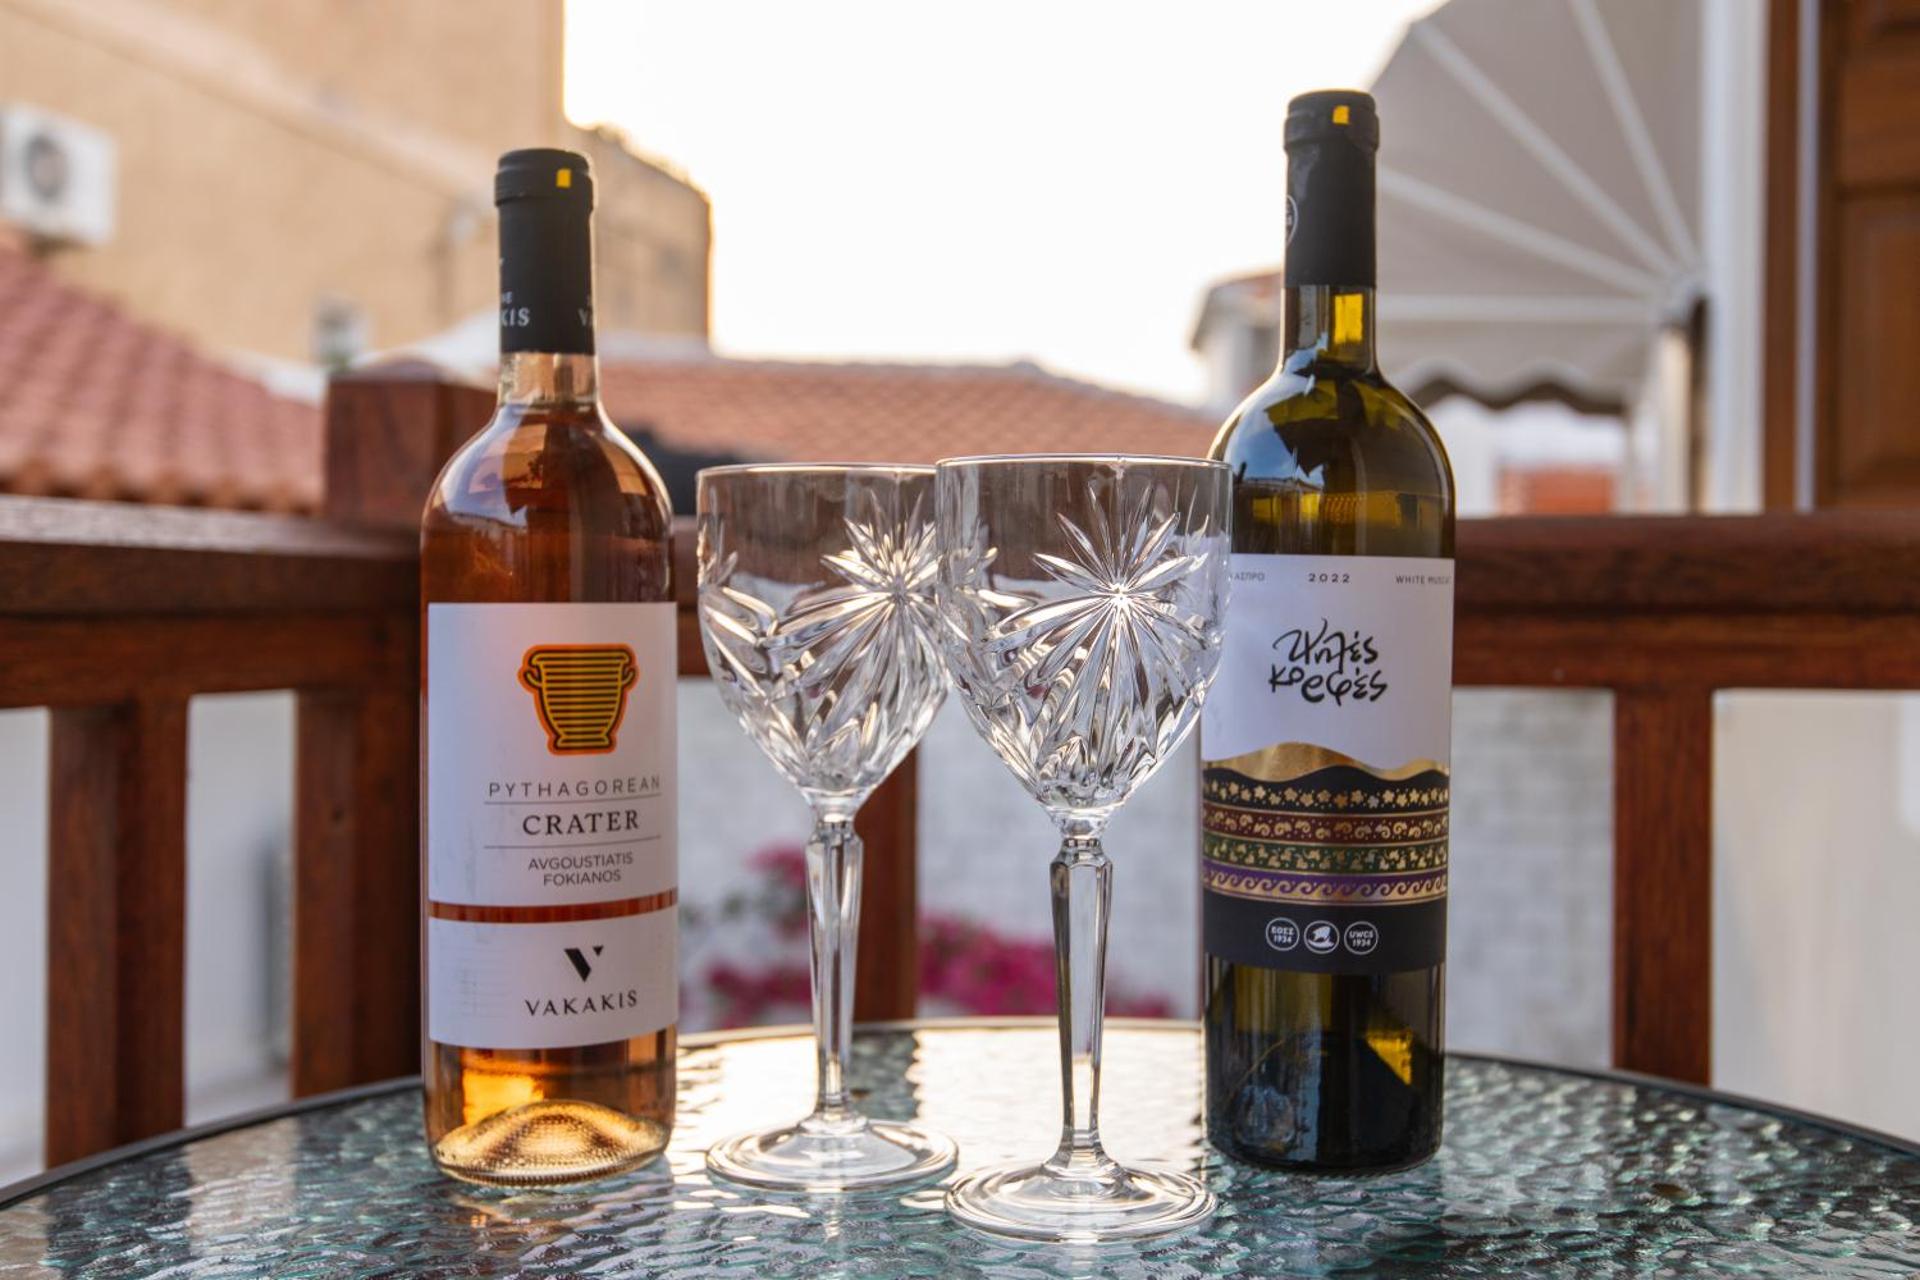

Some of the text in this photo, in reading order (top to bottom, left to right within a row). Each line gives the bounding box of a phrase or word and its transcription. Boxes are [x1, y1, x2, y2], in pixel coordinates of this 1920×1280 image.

[1308, 572, 1350, 583] 2022
[1395, 575, 1425, 585] WHITE
[489, 776, 660, 797] PYTHAGOREAN
[522, 809, 640, 836] CRATER
[528, 851, 634, 871] AVGOUSTIATIS
[543, 869, 621, 887] FOKIANOS
[525, 989, 638, 1017] VAKAKIS
